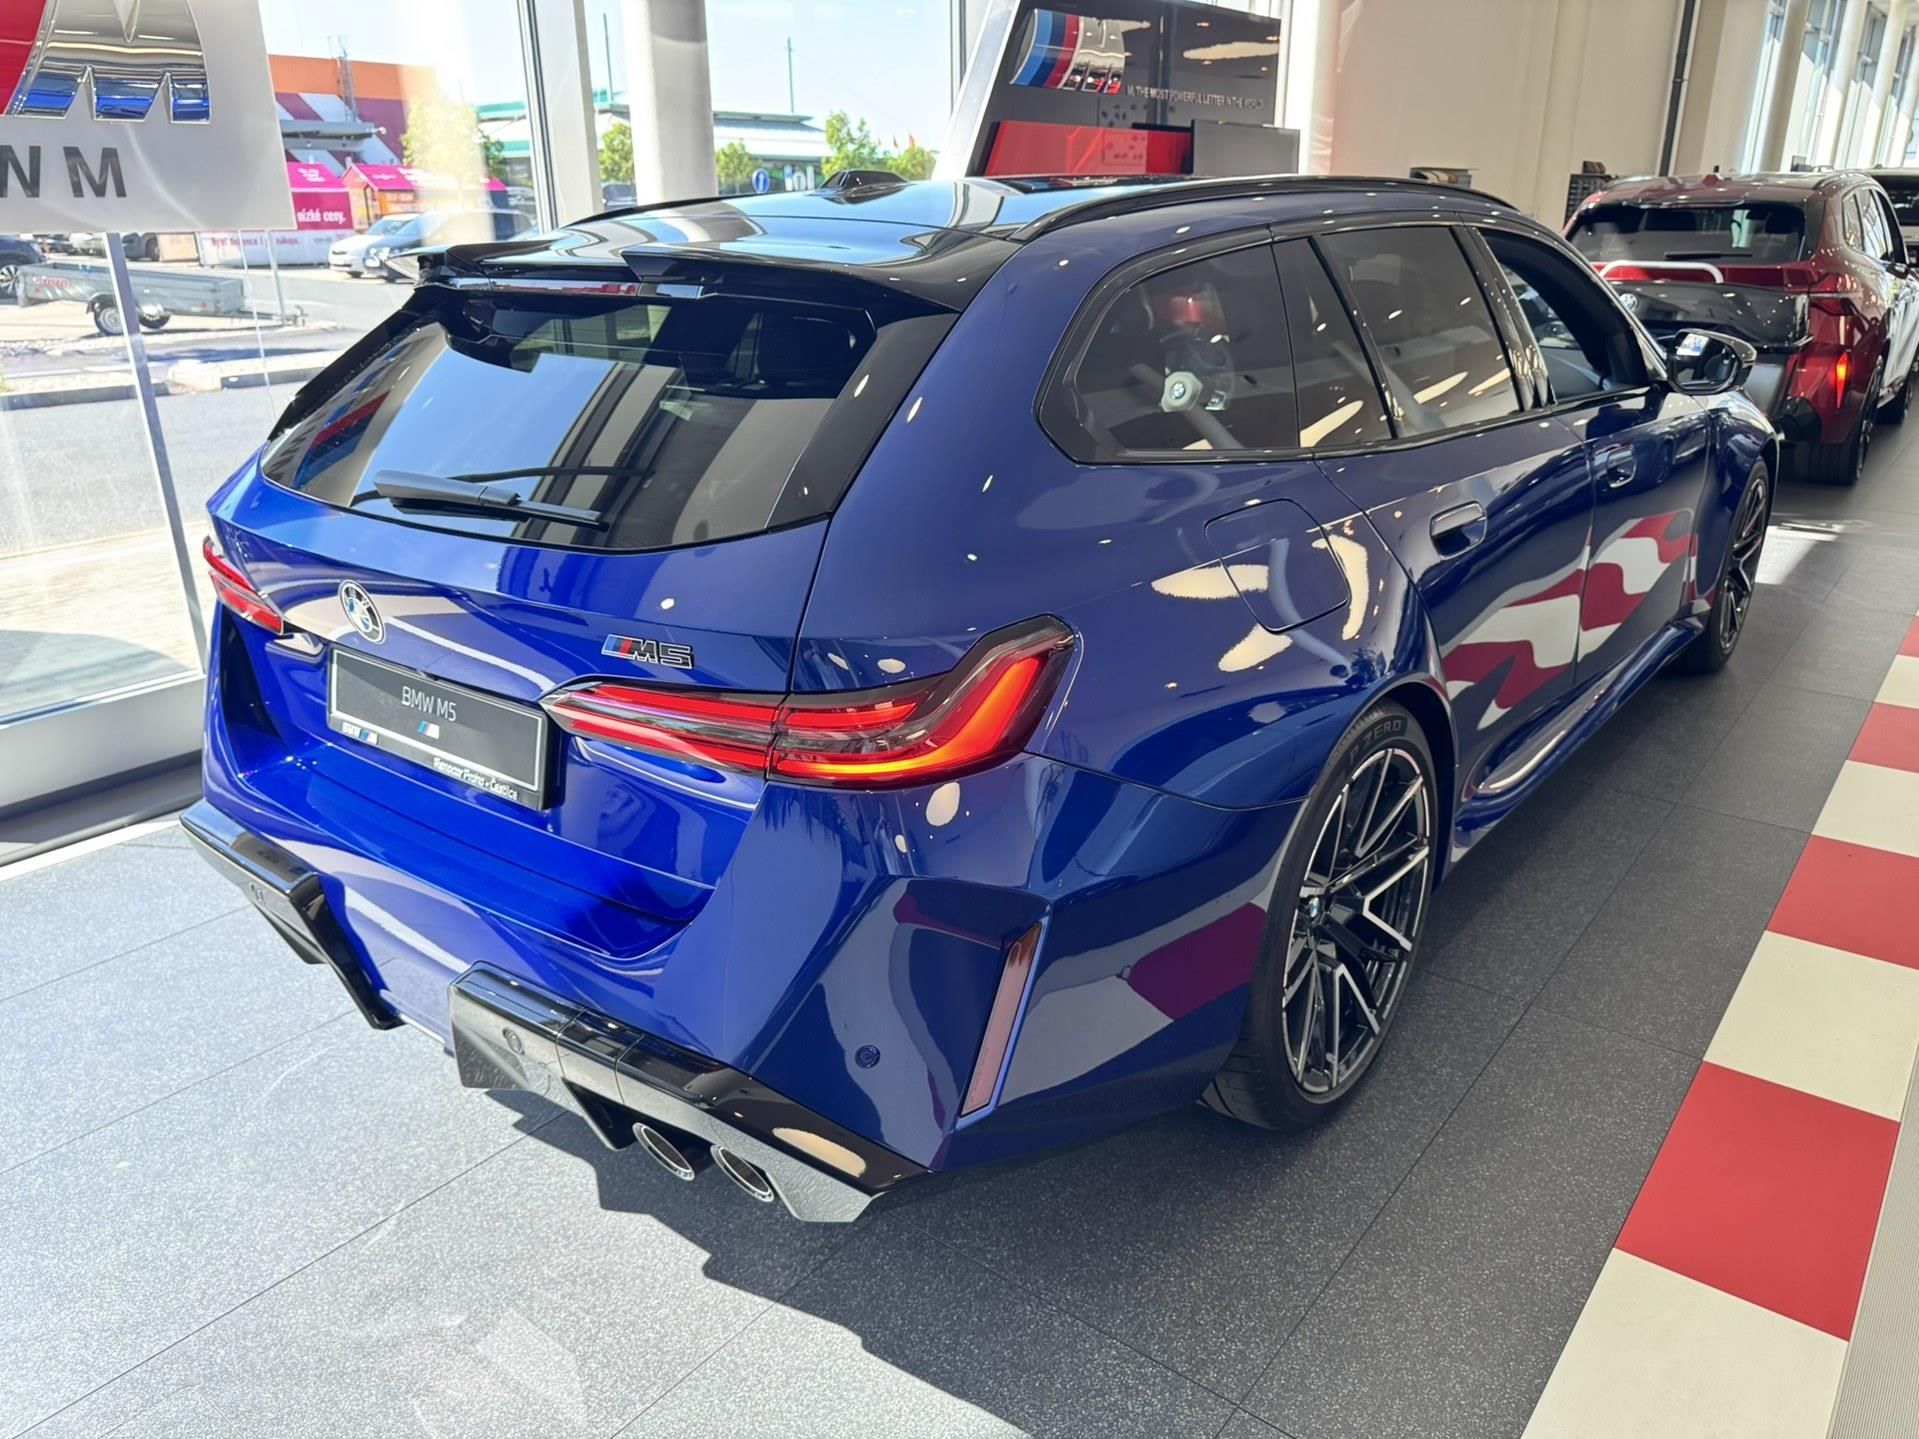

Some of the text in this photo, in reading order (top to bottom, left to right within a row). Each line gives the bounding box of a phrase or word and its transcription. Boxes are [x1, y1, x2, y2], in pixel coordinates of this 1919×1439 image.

[1150, 88, 1169, 100] MOST
[401, 686, 457, 722] BMW M5
[1350, 719, 1401, 767] P ZERO
